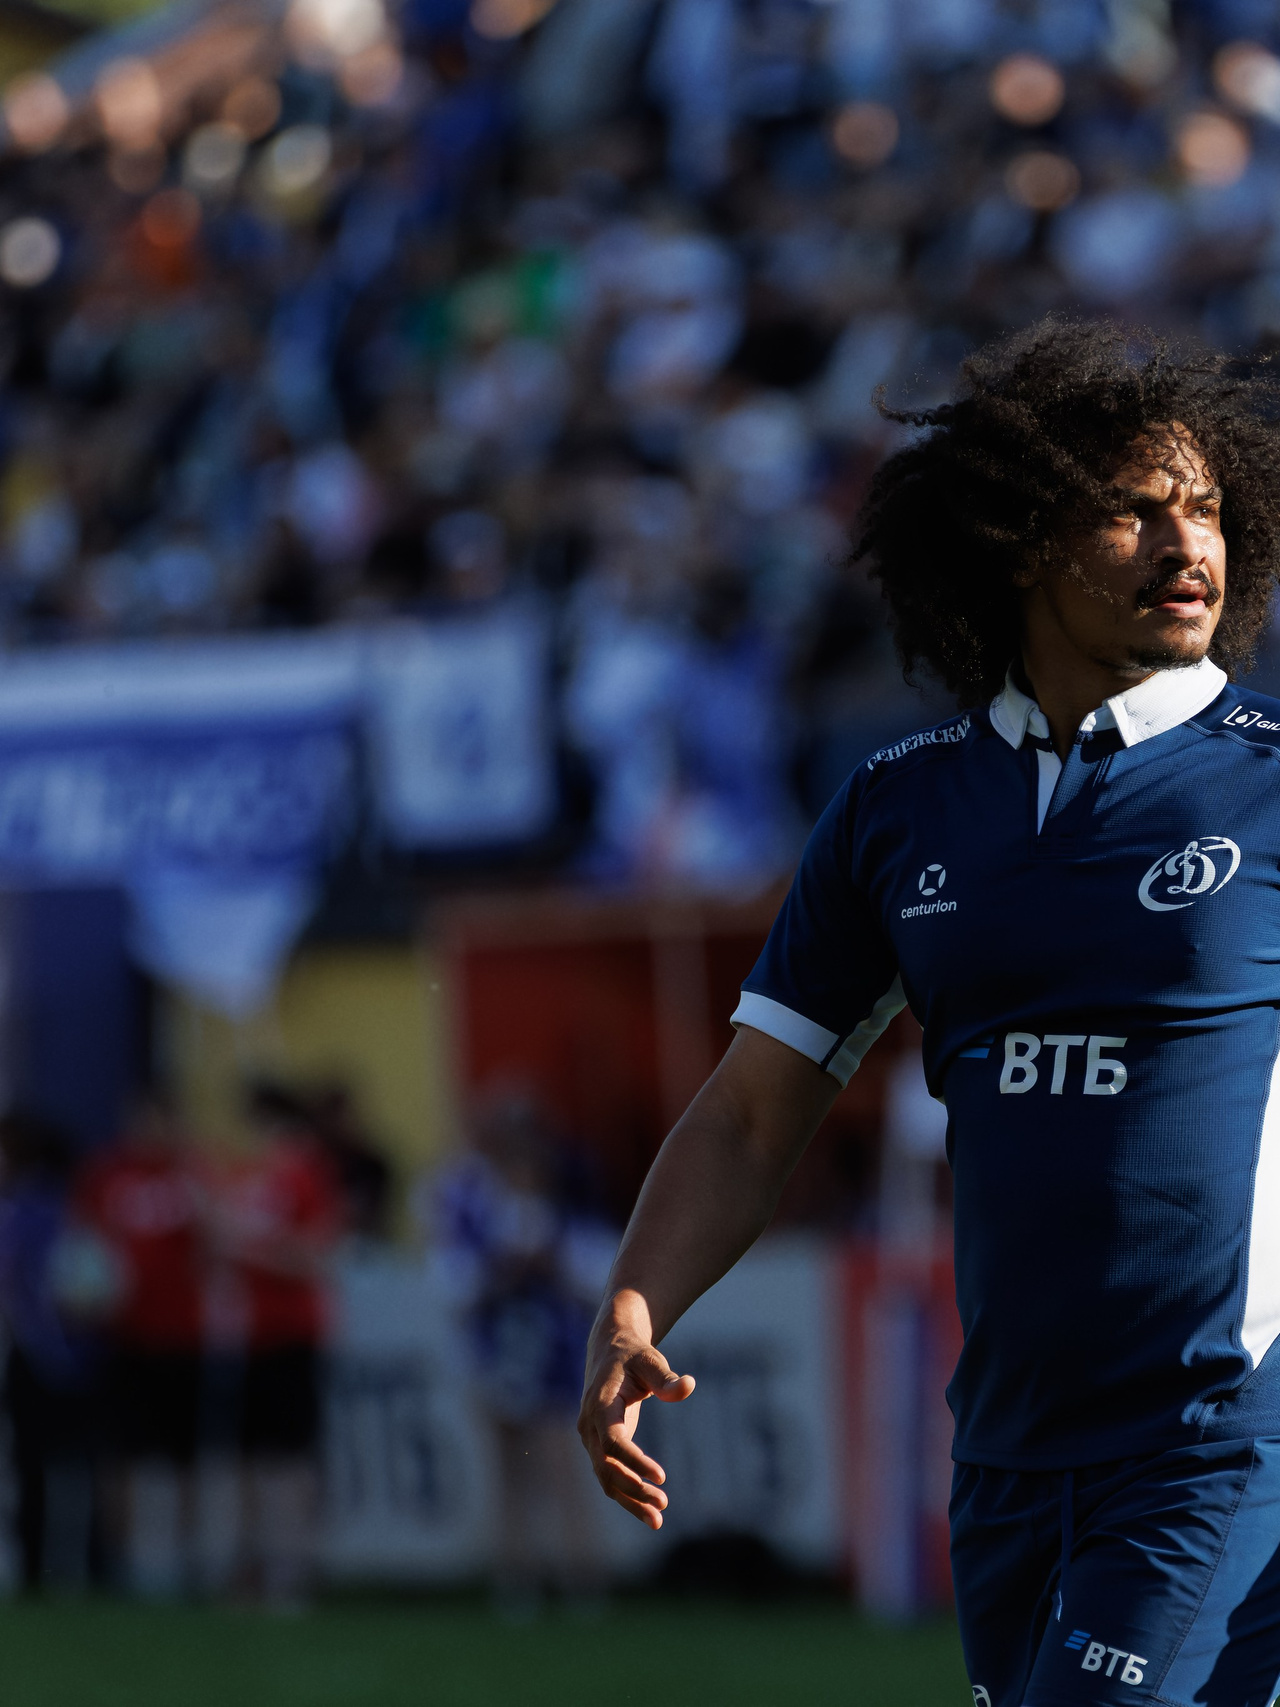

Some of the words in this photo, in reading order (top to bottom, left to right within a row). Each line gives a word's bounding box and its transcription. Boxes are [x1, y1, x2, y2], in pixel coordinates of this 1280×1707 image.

[901, 899, 957, 919] centurion
[999, 1032, 1128, 1095] ВТБ
[1081, 1641, 1148, 1686] ВТБ
